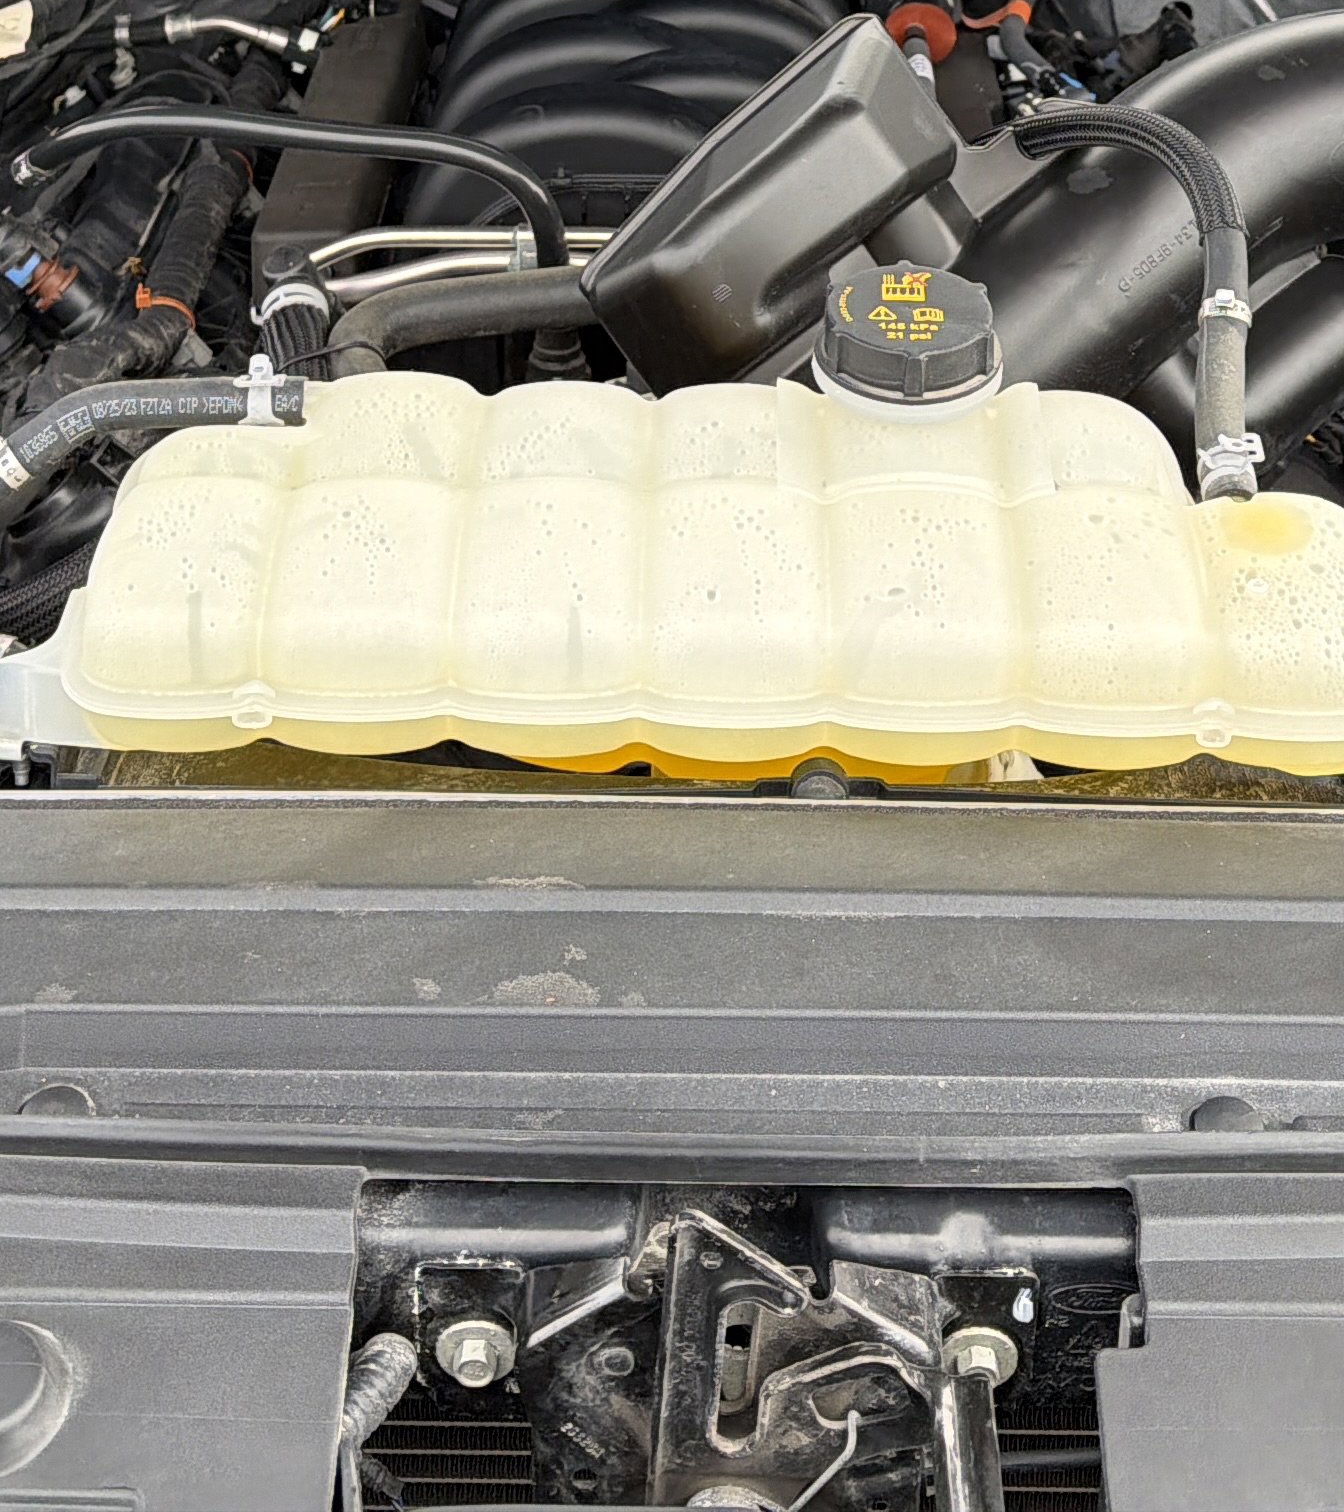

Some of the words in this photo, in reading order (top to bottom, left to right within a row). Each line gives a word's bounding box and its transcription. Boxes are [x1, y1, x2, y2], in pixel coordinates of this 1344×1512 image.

[878, 322, 906, 331] 145
[909, 322, 939, 331] kPa
[886, 331, 904, 340] 21
[909, 331, 933, 342] psi
